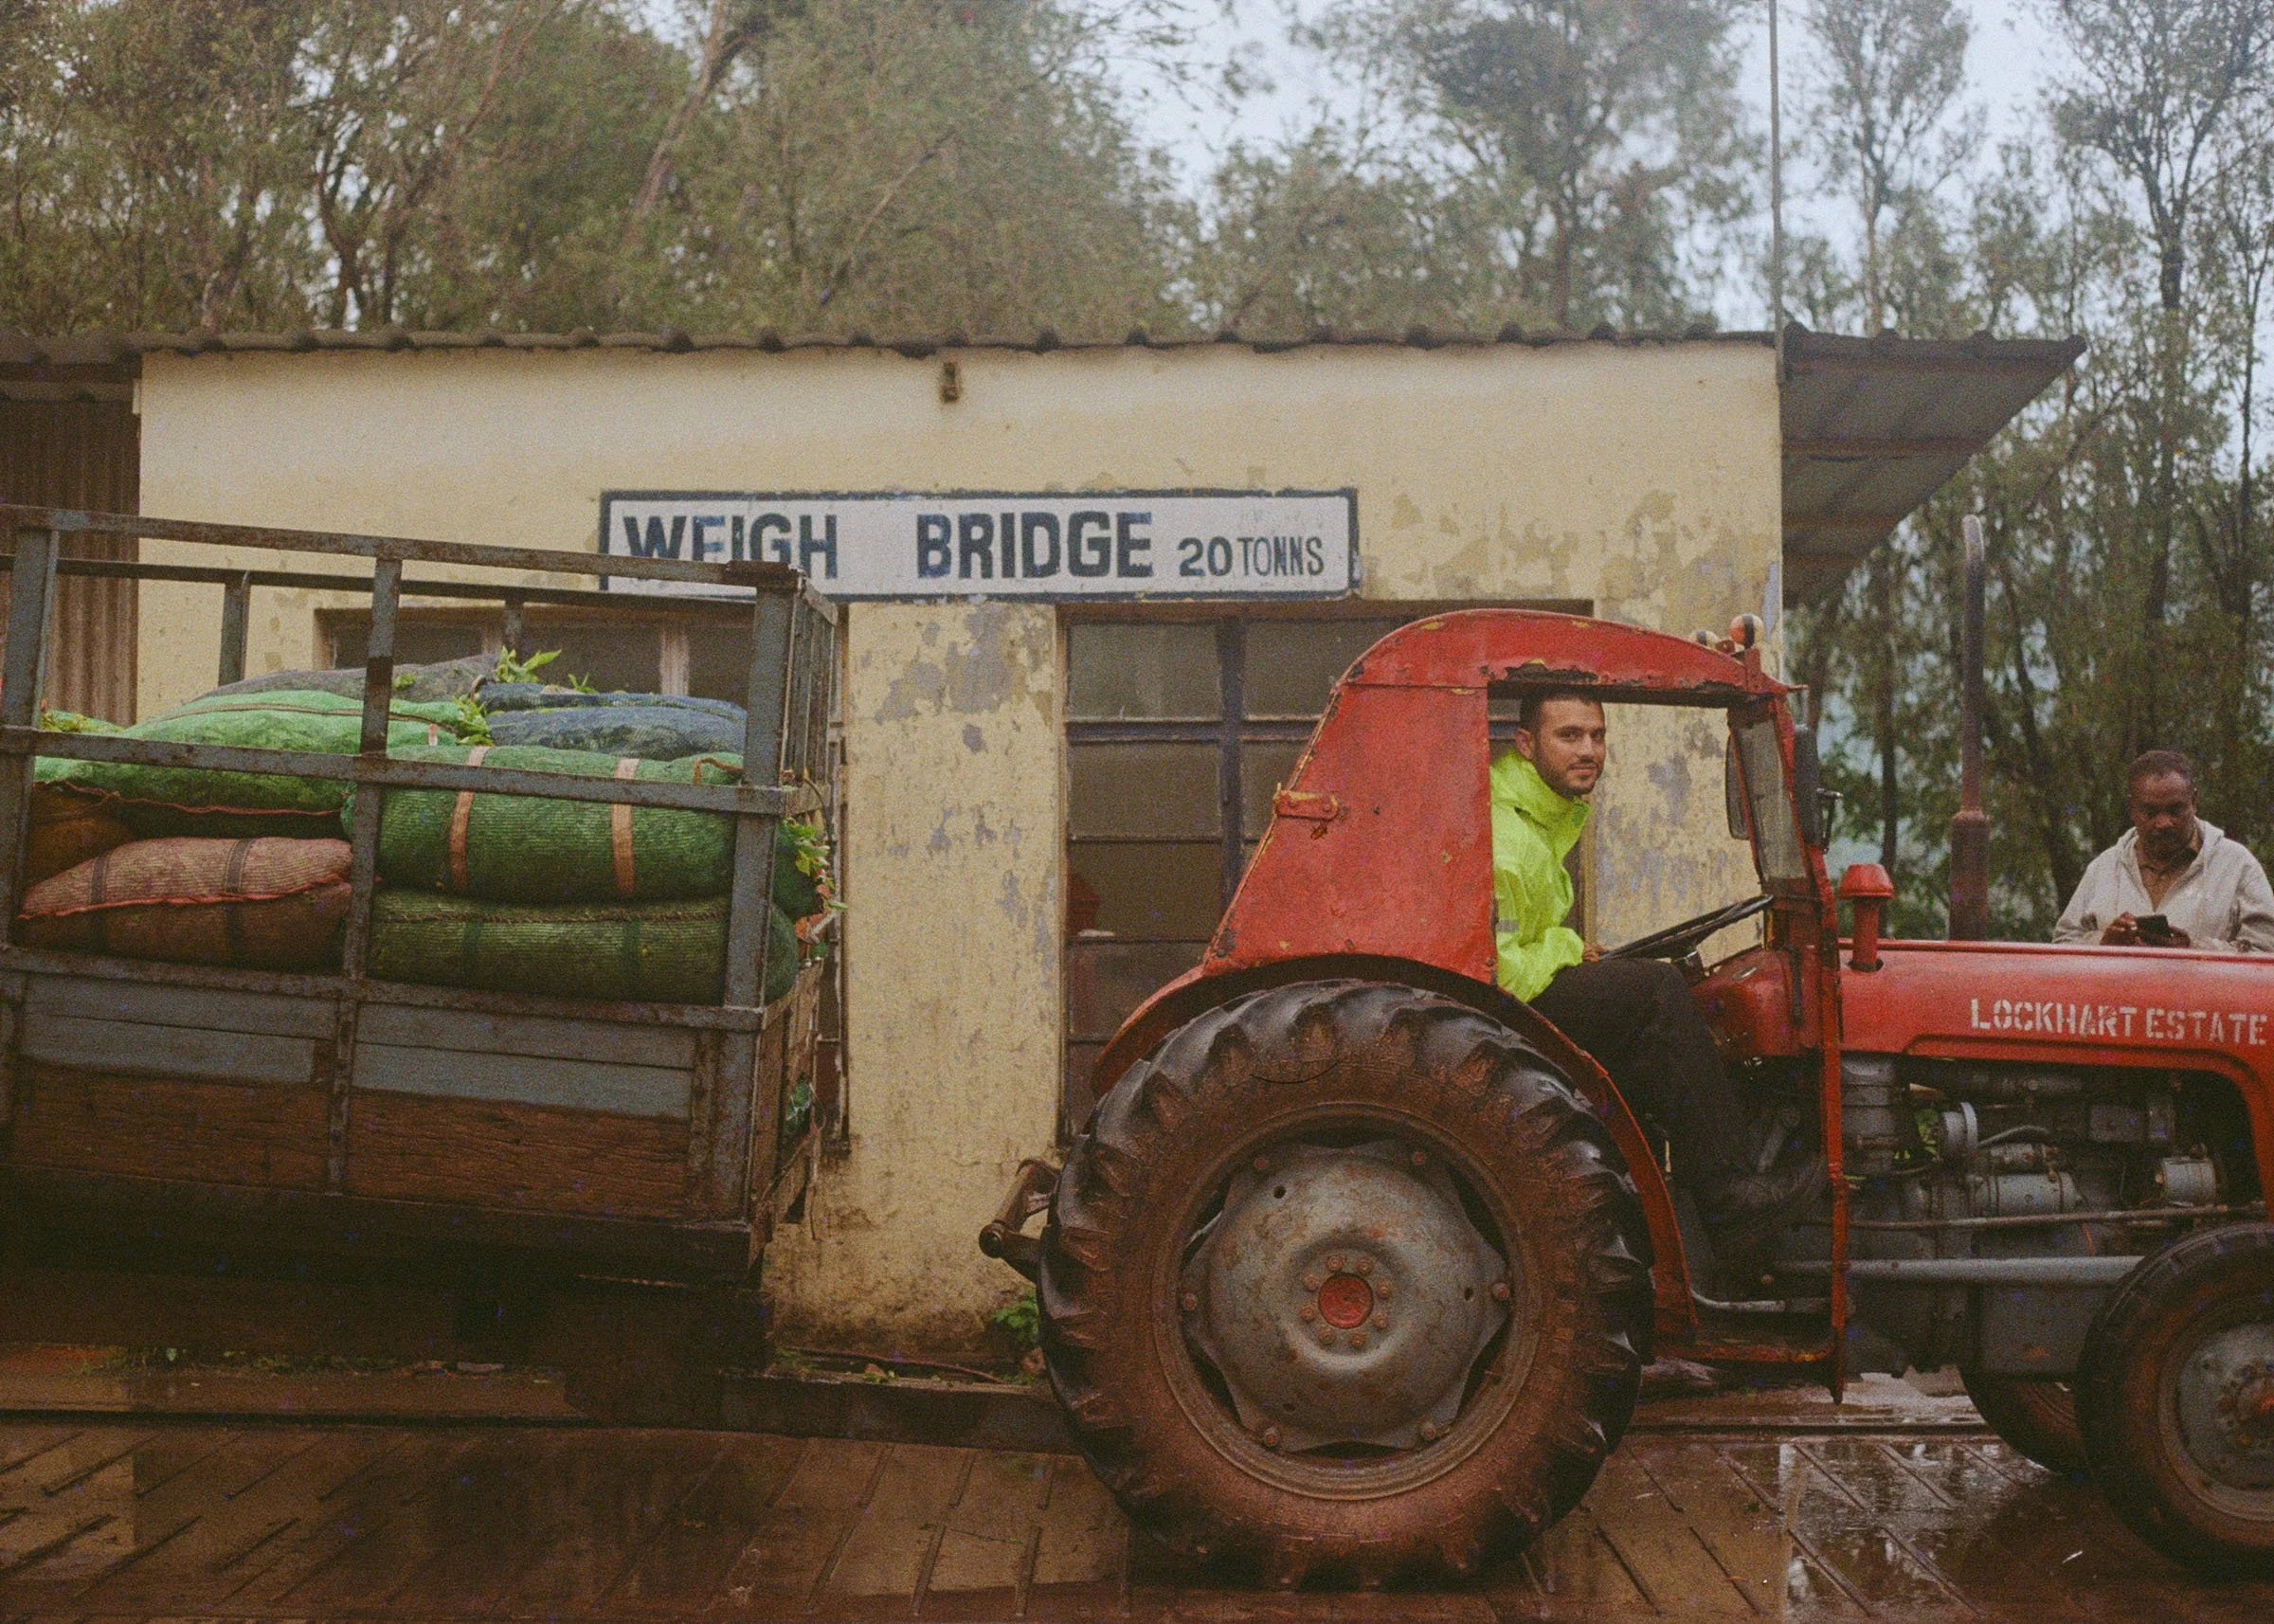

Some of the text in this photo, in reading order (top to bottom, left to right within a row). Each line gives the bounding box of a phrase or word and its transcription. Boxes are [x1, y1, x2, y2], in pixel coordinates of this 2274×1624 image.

[916, 512, 1154, 579] BRIDGE
[1178, 537, 1233, 577] 20
[1237, 536, 1325, 576] TONNS
[1971, 999, 2267, 1046] LOCKHART ESTATE
